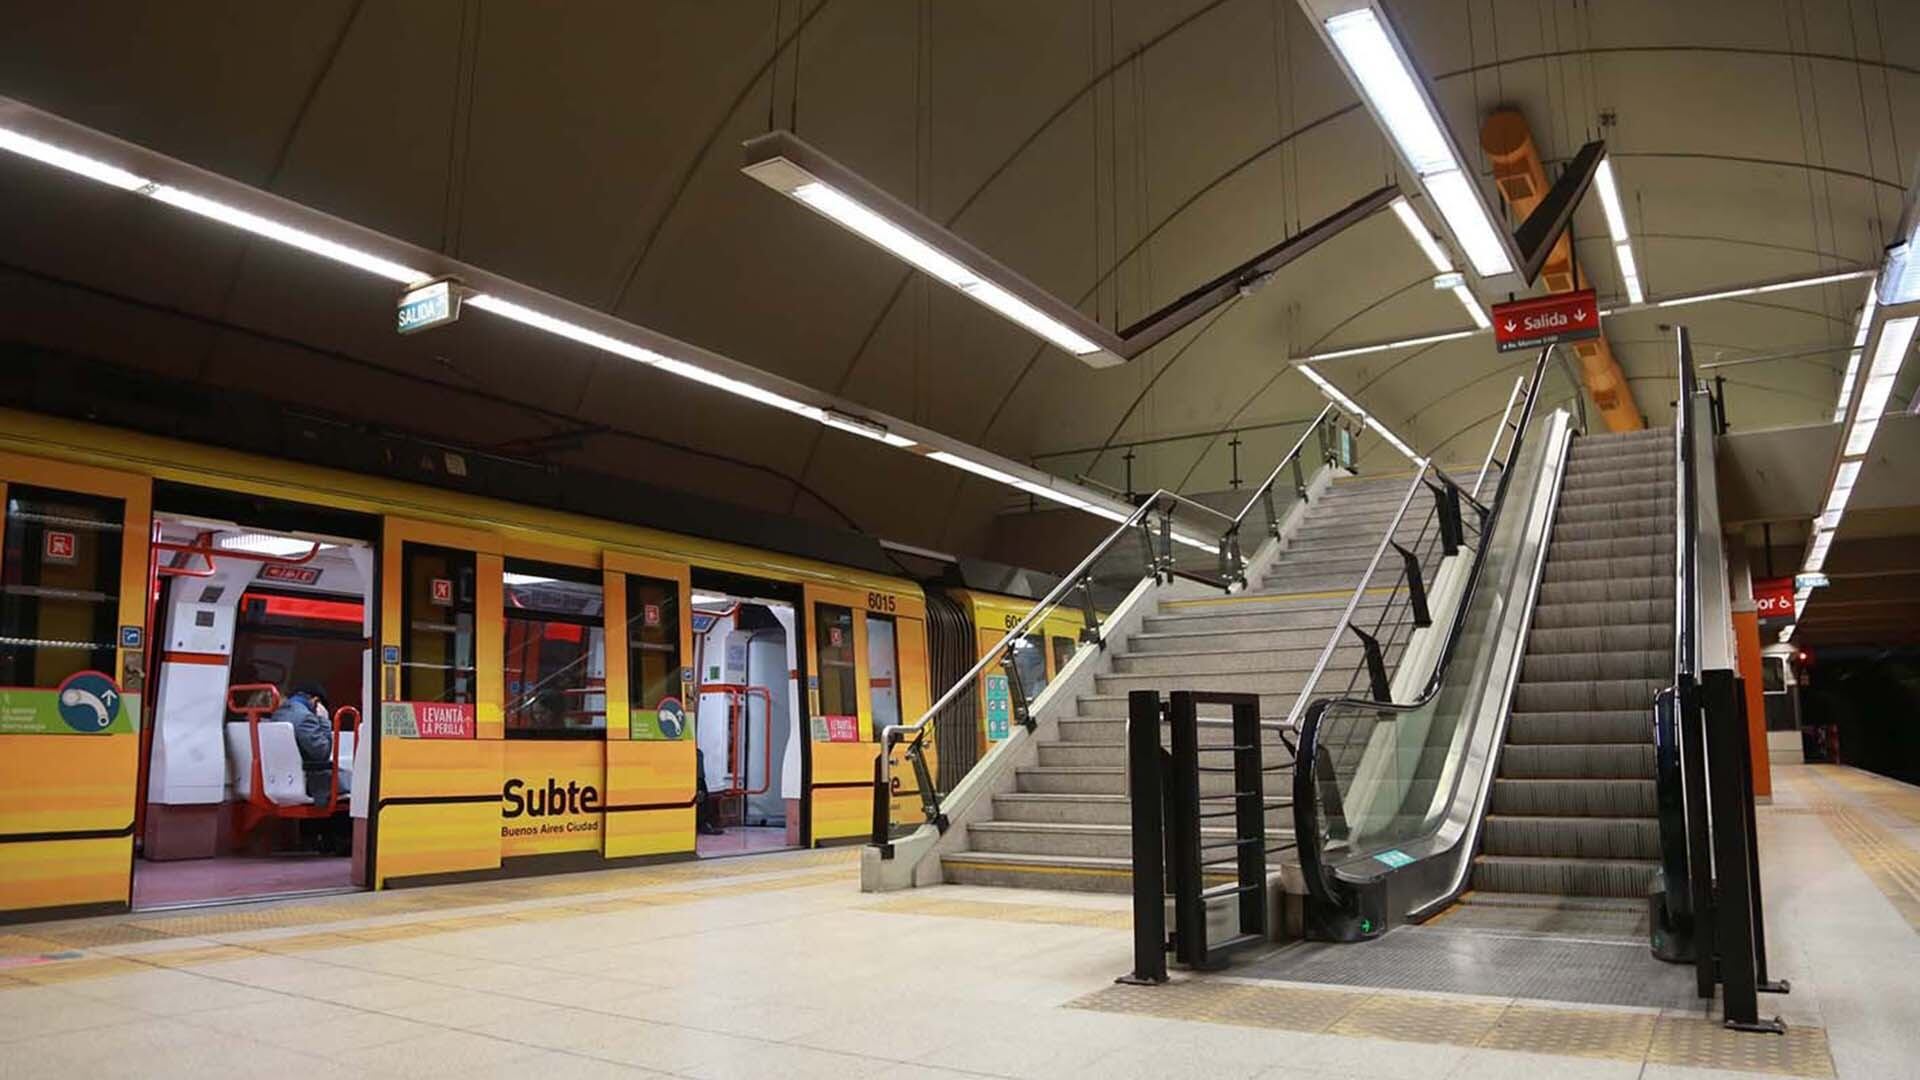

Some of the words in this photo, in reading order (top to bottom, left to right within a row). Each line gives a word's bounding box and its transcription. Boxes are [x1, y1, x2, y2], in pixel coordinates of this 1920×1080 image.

[1523, 312, 1568, 330] Salida
[868, 592, 896, 611] 6015
[1755, 598, 1776, 610] or
[422, 705, 464, 723] LEVANTÁ
[422, 722, 433, 735] LA
[502, 778, 598, 818] Subte
[501, 826, 538, 837] Buenos
[540, 823, 565, 834] Aires
[566, 821, 598, 832] Ciudad
